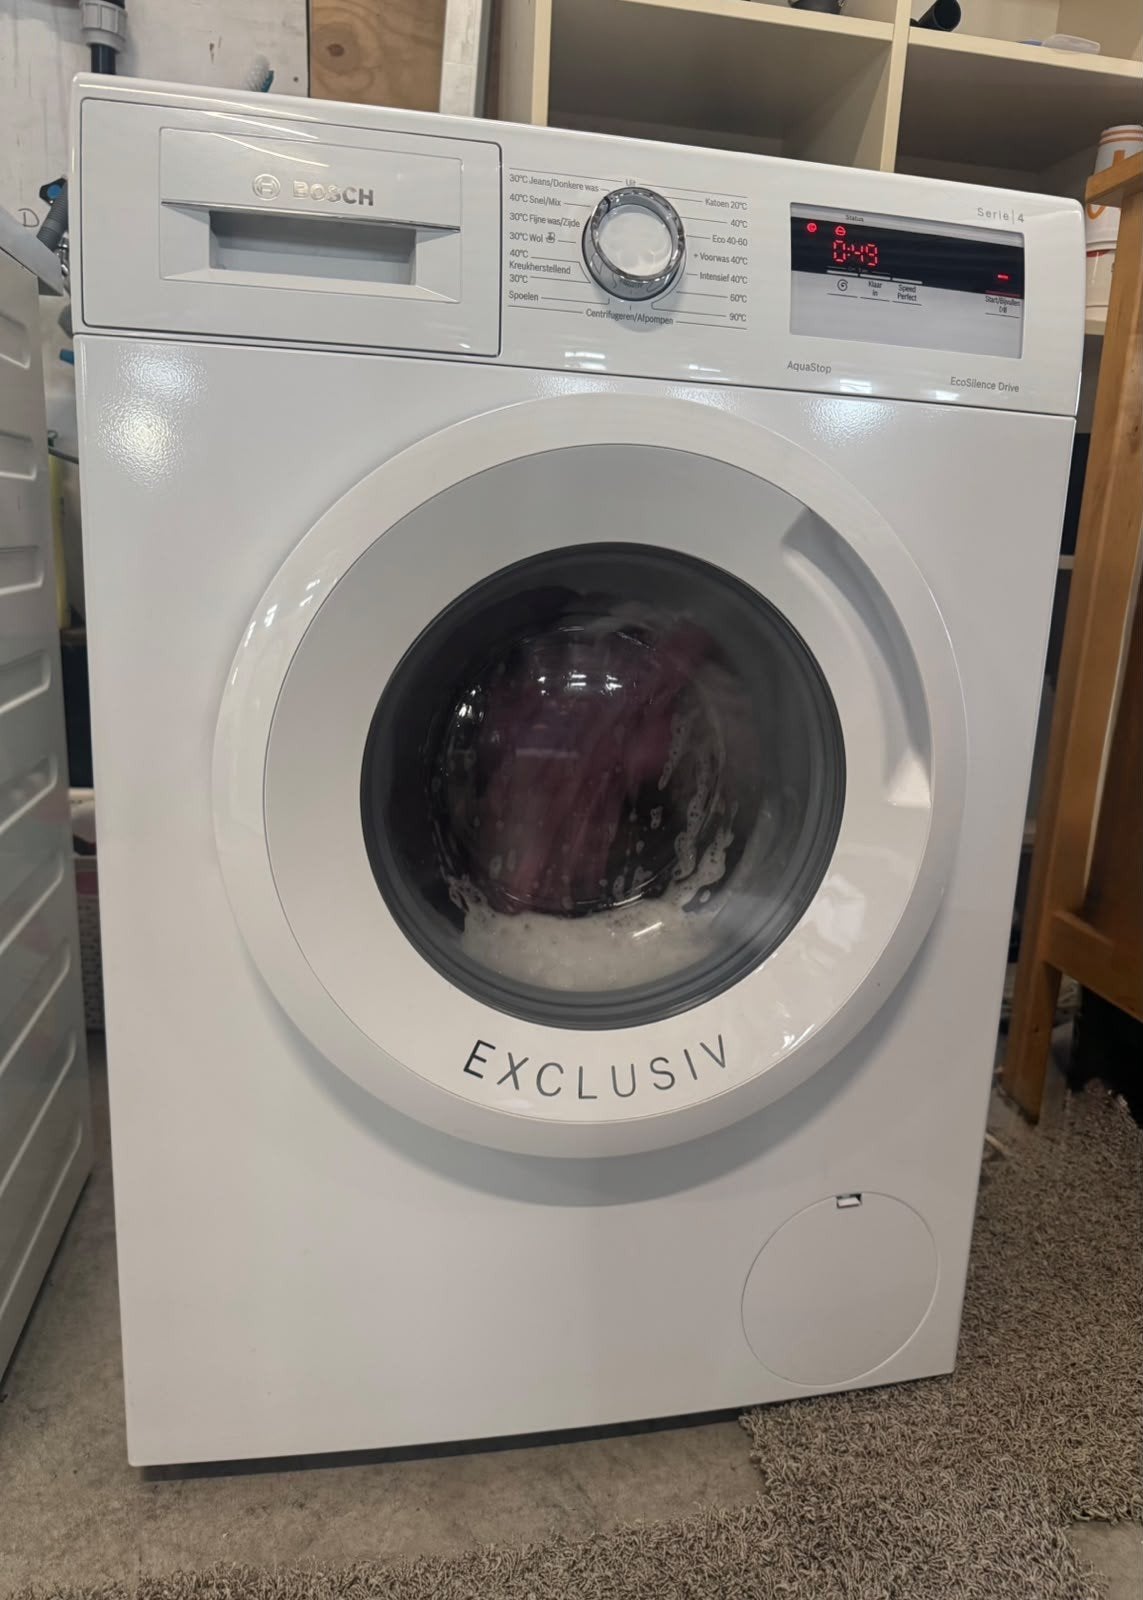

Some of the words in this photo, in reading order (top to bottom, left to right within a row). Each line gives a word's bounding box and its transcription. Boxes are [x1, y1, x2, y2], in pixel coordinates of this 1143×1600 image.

[509, 173, 528, 184] 30°C
[529, 177, 584, 190] Jeans/Donkere
[293, 180, 375, 206] BOSCH
[509, 193, 528, 203] 40°C
[529, 195, 562, 207] Snel/Mix
[705, 198, 730, 209] Katoen
[730, 201, 748, 211] 20°C
[509, 212, 528, 222] 30°C
[529, 214, 547, 225] Fijne
[547, 218, 581, 228] was/Zijde
[730, 219, 748, 229] 40°C
[845, 214, 864, 222] Status
[509, 231, 528, 242] 30°C
[529, 233, 543, 243] Wol
[712, 234, 726, 244] Eco
[726, 236, 748, 247] 40-60
[509, 249, 529, 259] 40°C
[700, 252, 730, 264] Voorwas
[730, 255, 749, 266] 40°C
[833, 239, 878, 267] 0:49
[509, 261, 571, 275] Kreukherstellend
[509, 274, 528, 284] 30°C
[700, 271, 730, 283] Intensief
[730, 274, 749, 285] 40°C
[868, 280, 883, 289] Klaar
[872, 289, 879, 297] in
[898, 284, 917, 294] Speed
[508, 290, 539, 302] Spoelen
[897, 292, 917, 302] Perfect
[586, 308, 674, 326] Centrifugeren/Afpompen
[787, 360, 832, 375] AquaStop
[950, 376, 996, 391] EcoSilence
[998, 380, 1020, 393] Drive
[463, 1034, 726, 1100] EXCLUSIV
